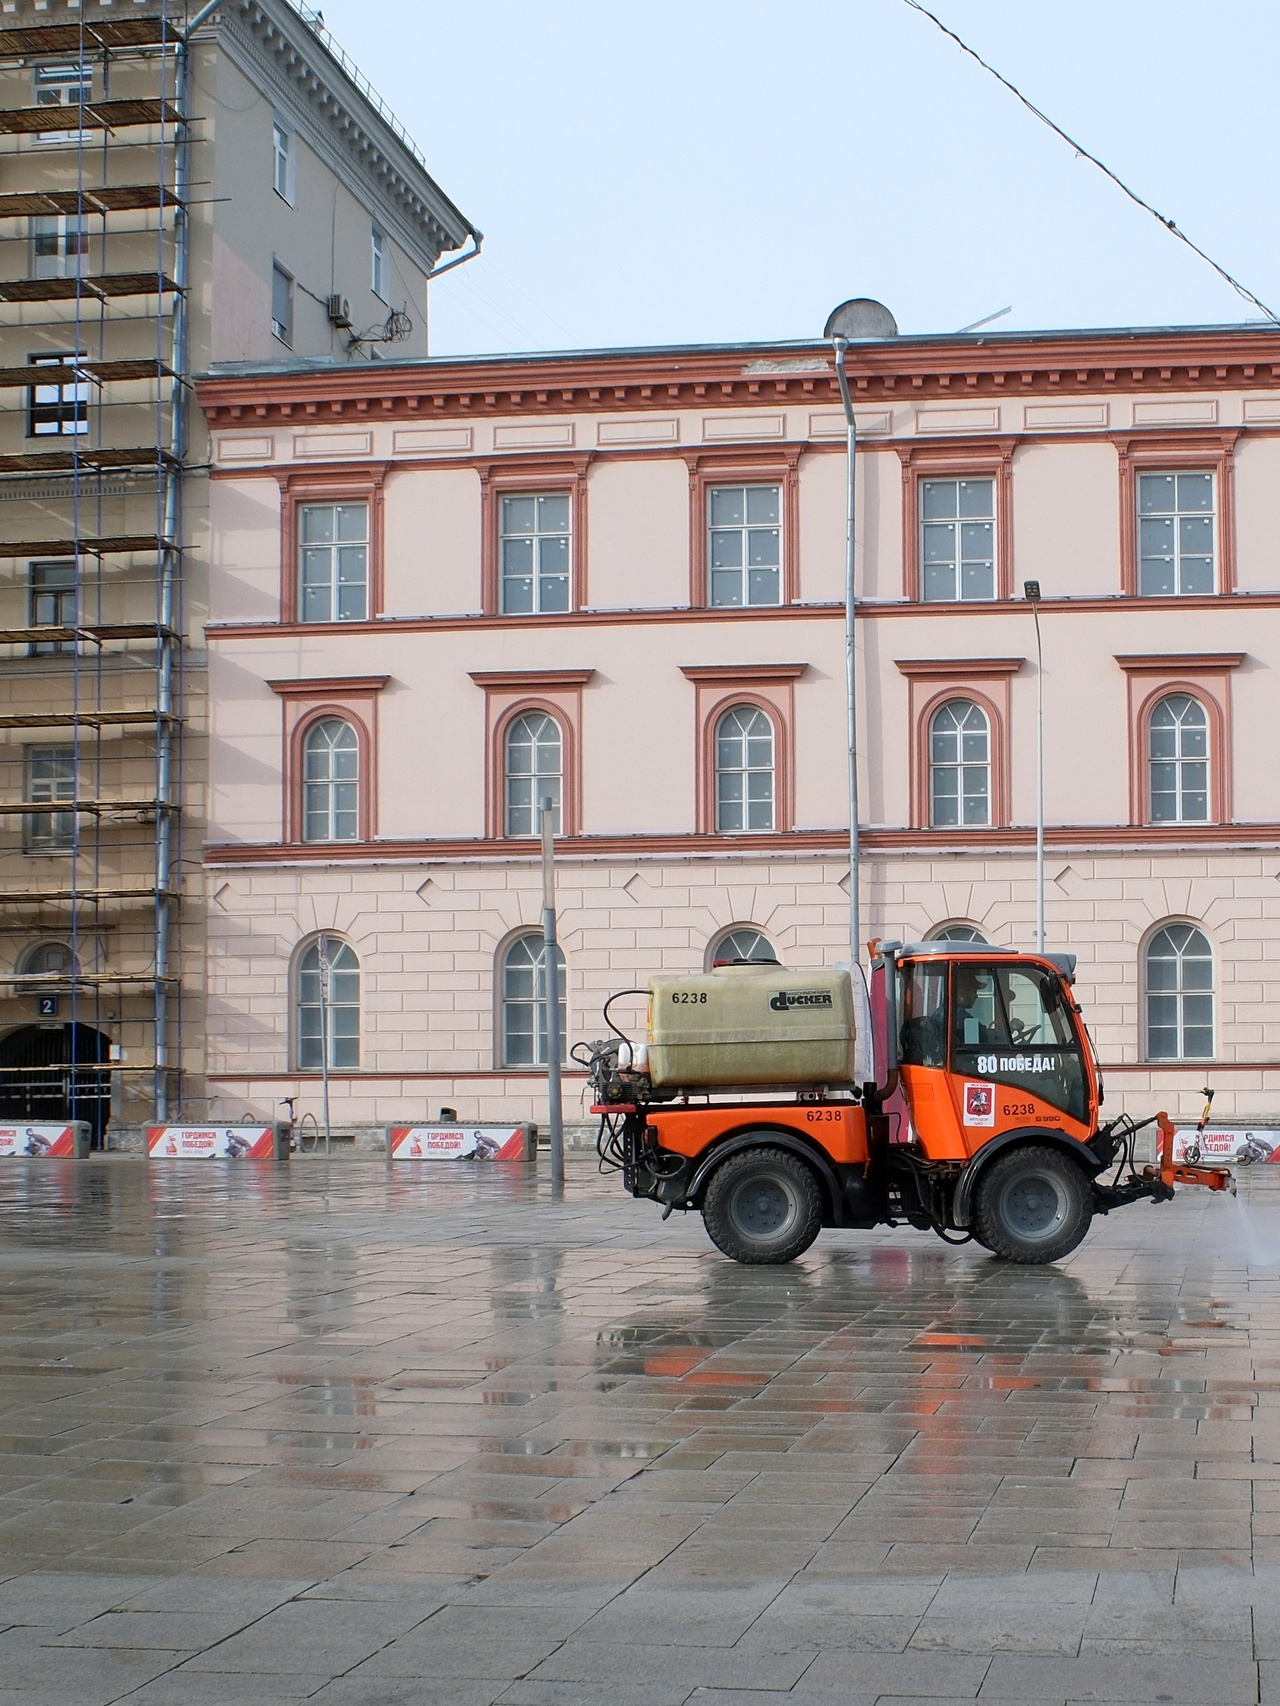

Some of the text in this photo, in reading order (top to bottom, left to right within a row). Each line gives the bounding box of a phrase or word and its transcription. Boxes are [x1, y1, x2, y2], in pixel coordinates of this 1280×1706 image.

[671, 992, 707, 1004] 6238
[43, 1000, 52, 1013] 2
[977, 1055, 1055, 1074] 80 ПОБЕДА!
[1003, 1103, 1035, 1116] 6238
[806, 1110, 842, 1122] 6238
[181, 1131, 216, 1140] ГОРДИМСЯ
[427, 1132, 464, 1141] ГОРДИМСЯ
[1202, 1134, 1235, 1143] РДИМСЯ
[181, 1140, 213, 1149] ПОБЕДОЙ!
[427, 1141, 461, 1150] ПОБЕДОЙ!
